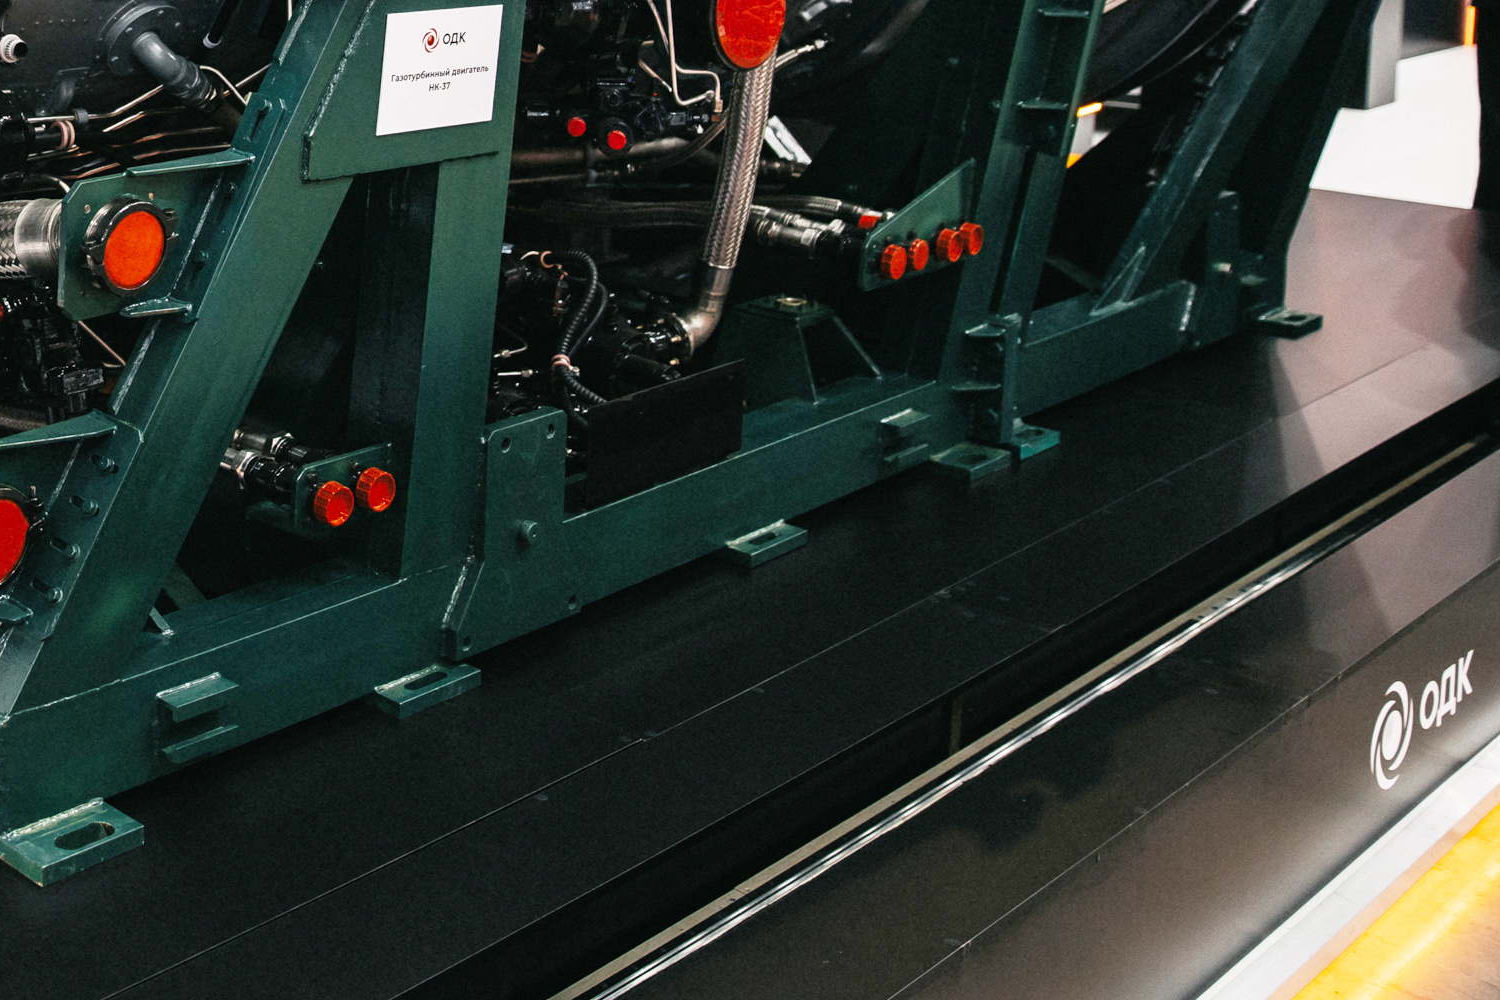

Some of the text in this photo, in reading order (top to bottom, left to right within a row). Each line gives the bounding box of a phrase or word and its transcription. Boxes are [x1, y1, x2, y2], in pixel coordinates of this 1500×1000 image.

[442, 32, 466, 45] ОДК
[391, 65, 489, 83] Газотурбинный двигатель
[428, 82, 450, 91] НК-37
[1419, 649, 1474, 730] ОДК
